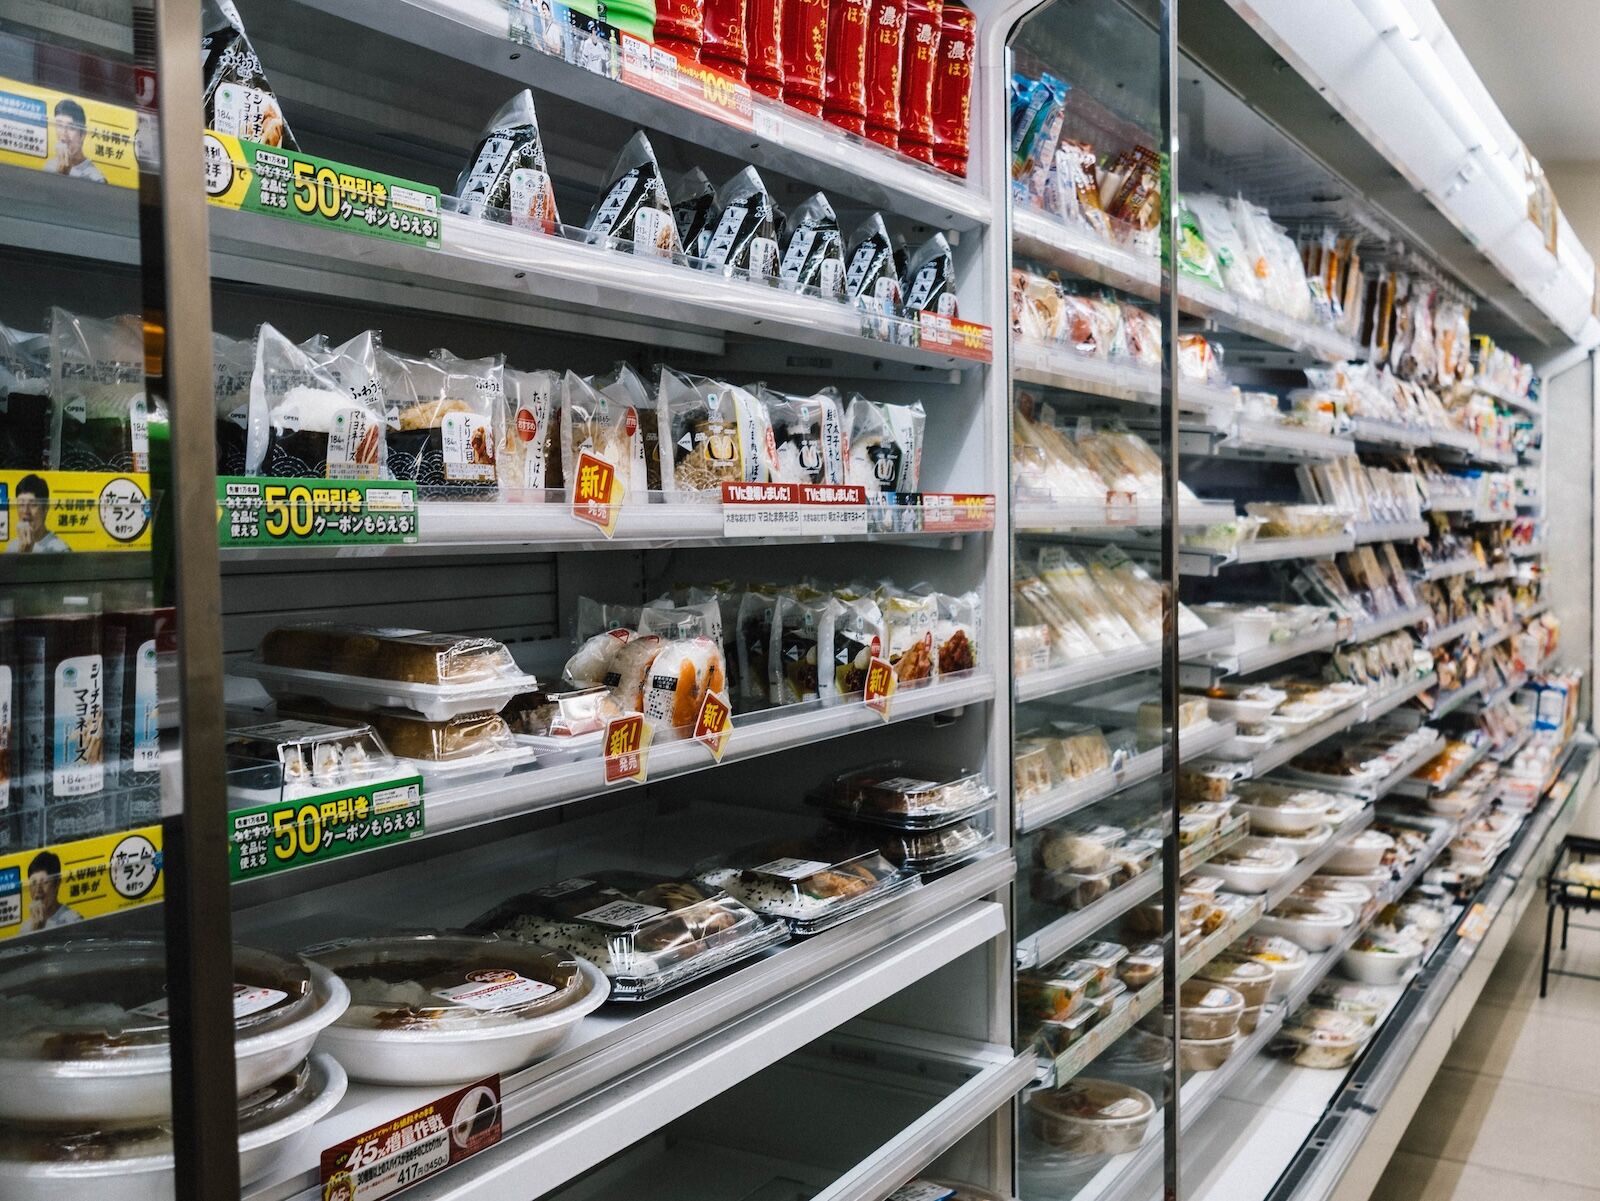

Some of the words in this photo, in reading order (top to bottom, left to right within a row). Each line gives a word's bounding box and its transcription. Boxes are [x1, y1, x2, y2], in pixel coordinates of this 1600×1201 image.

[94, 144, 125, 161] 選手が
[236, 167, 248, 181] で
[260, 178, 288, 194] 全品に
[260, 192, 288, 209] 使える
[340, 201, 440, 239] クーポンもらえる!
[66, 405, 85, 413] OPEN
[464, 416, 474, 462] とり五目
[105, 491, 142, 505] ホーム
[727, 485, 792, 502] TVに登場しました!
[803, 487, 859, 503] TVに登場しました!
[225, 496, 262, 510] おむすび
[58, 514, 90, 527] 選手が
[112, 506, 136, 521] ラン
[230, 510, 259, 525] 全品に
[115, 525, 134, 533] を打つ
[230, 523, 259, 538] 使える
[314, 514, 416, 535] クーポンもらえる!
[74, 688, 89, 763] マヨネーズ
[619, 755, 638, 771] 発売
[234, 826, 273, 843] おむすび
[322, 809, 421, 848] クーポンもらえる!
[116, 846, 152, 866] ホーム
[239, 840, 268, 857] 全品に
[239, 856, 268, 870] 使える
[123, 864, 146, 881] ラン
[69, 880, 100, 897] 選手が
